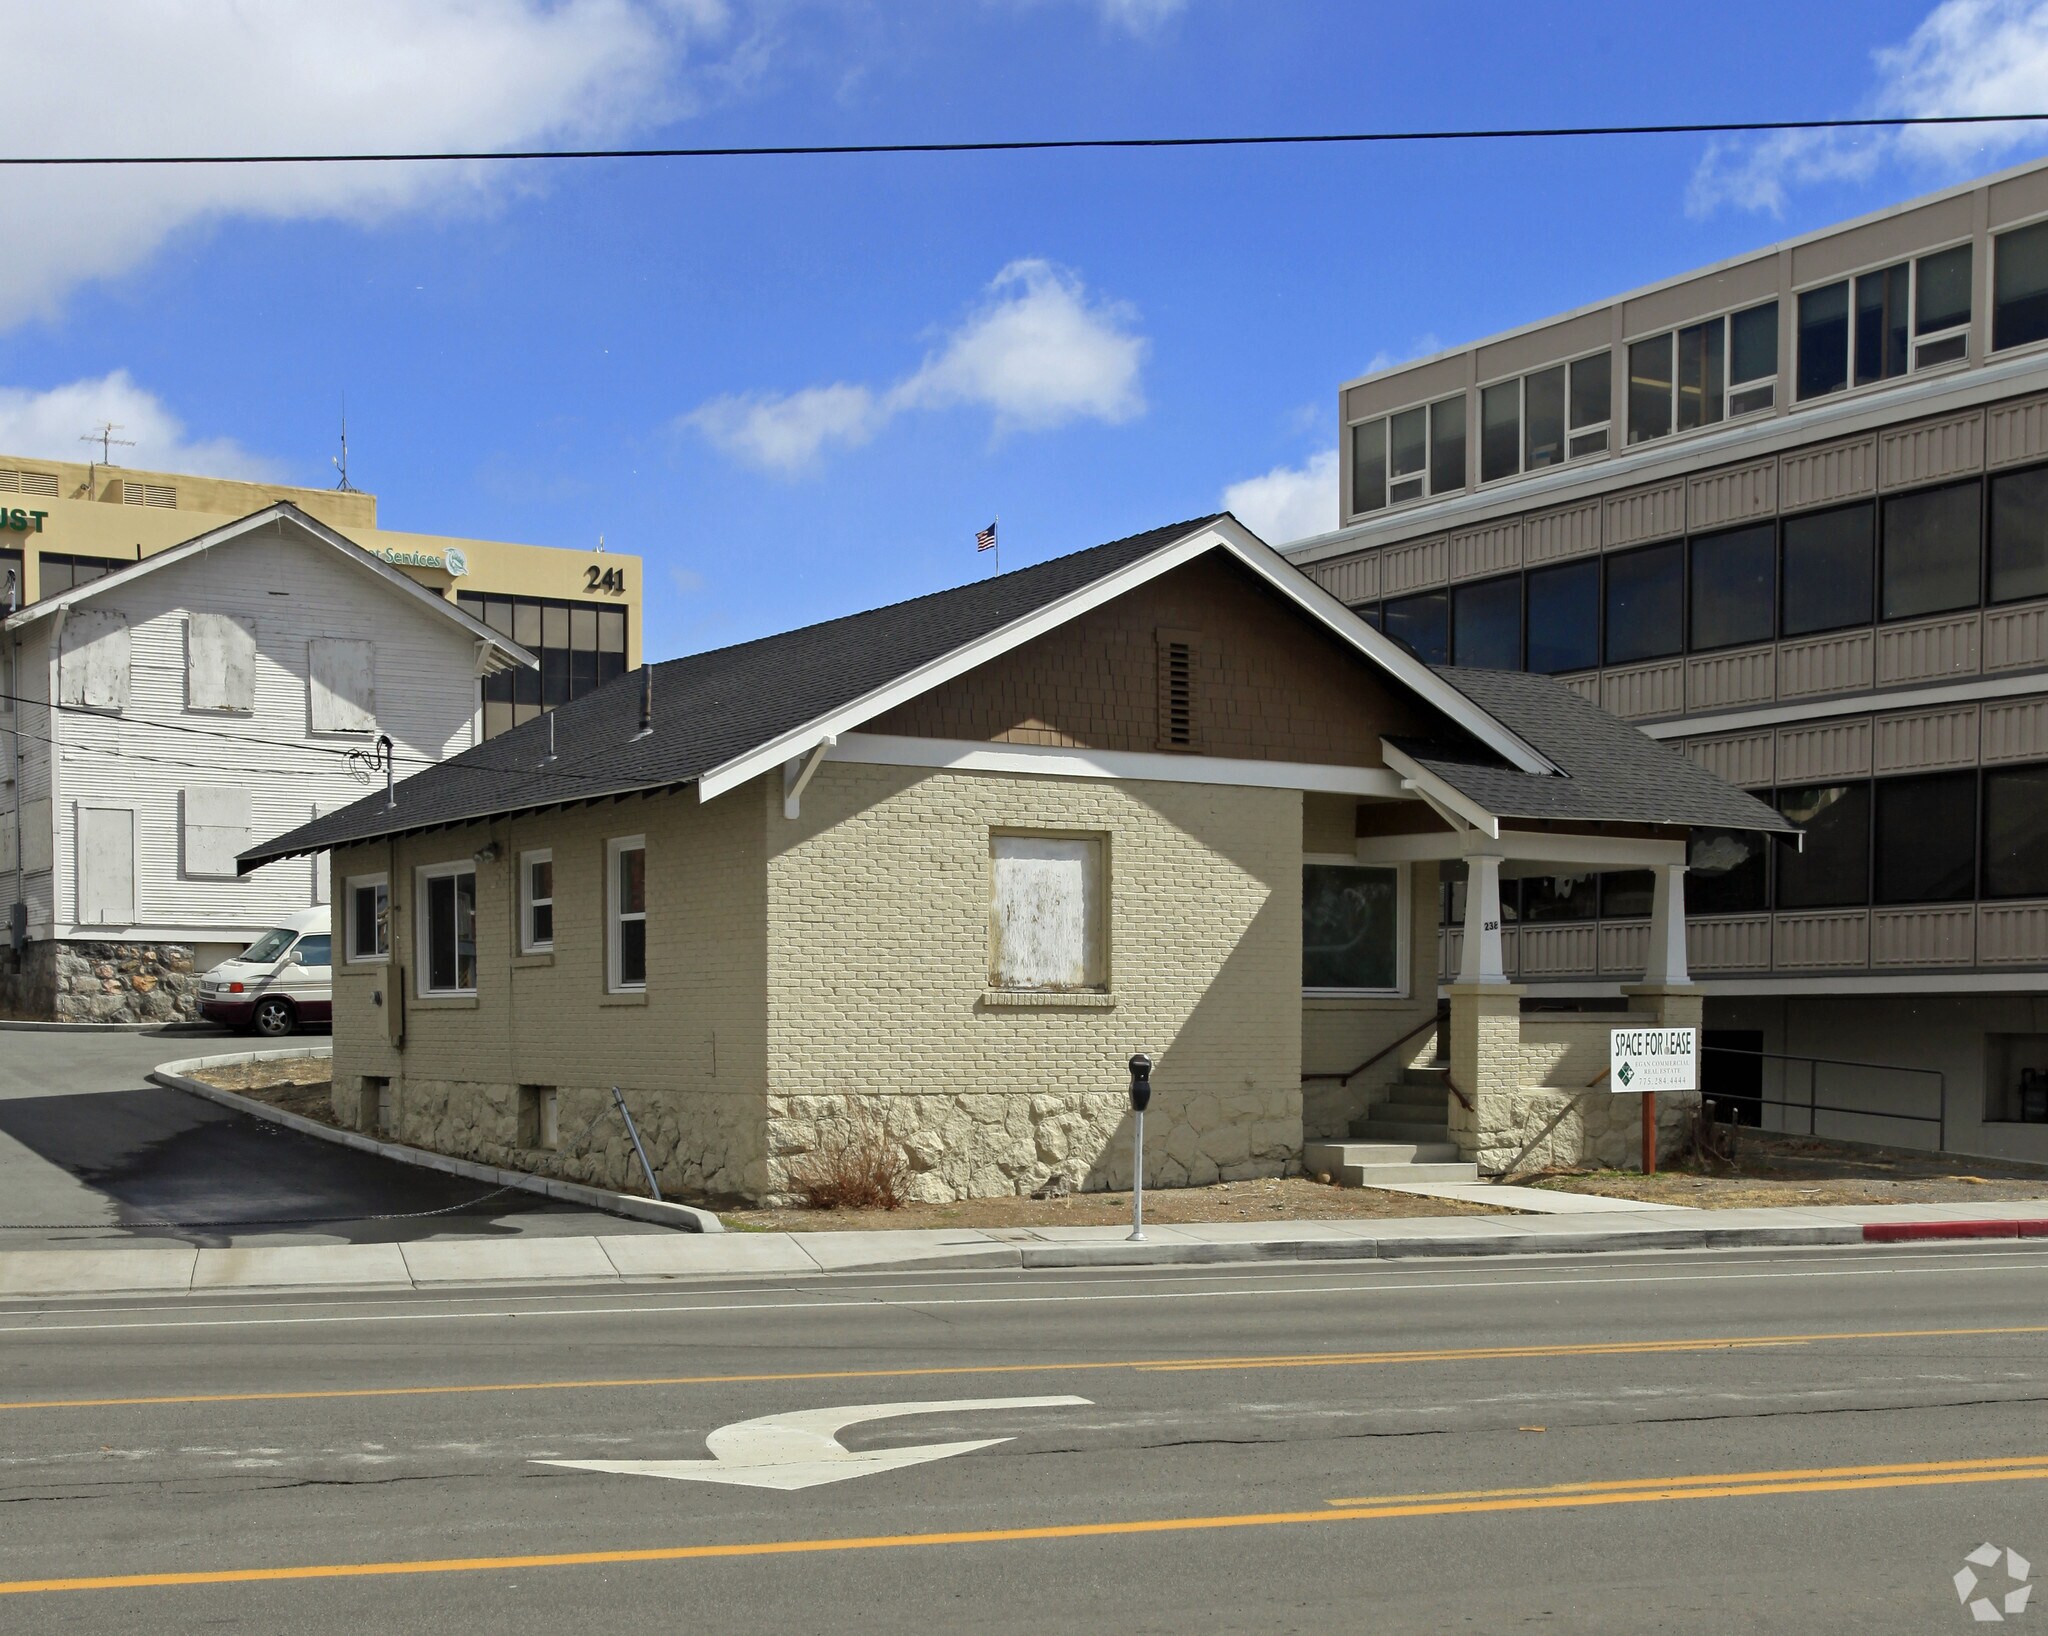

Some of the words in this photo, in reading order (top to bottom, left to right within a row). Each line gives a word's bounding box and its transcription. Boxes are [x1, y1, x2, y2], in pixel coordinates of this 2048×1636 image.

[385, 547, 441, 567] Services
[586, 565, 626, 592] 241
[1615, 1033, 1642, 1056] SPACE
[1645, 1032, 1663, 1055] FOR
[1639, 1076, 1686, 1085] 775.284.4444
